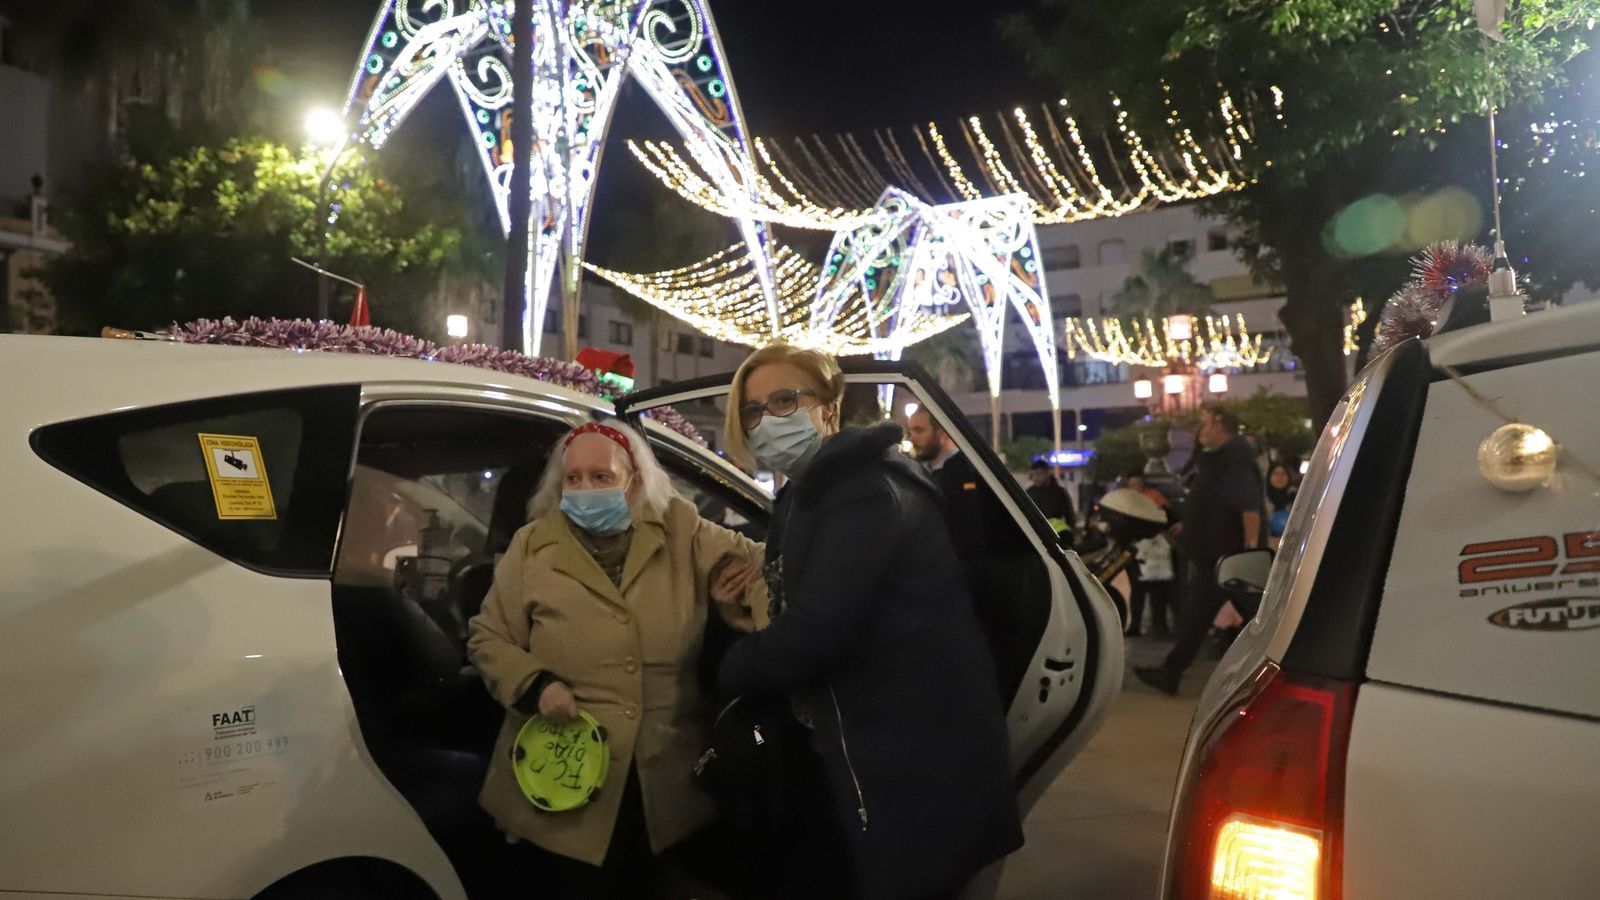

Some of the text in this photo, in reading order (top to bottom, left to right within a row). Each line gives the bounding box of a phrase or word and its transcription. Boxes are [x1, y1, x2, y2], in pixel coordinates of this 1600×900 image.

[212, 708, 254, 726] FAAT
[205, 736, 289, 761] 900 200 999
